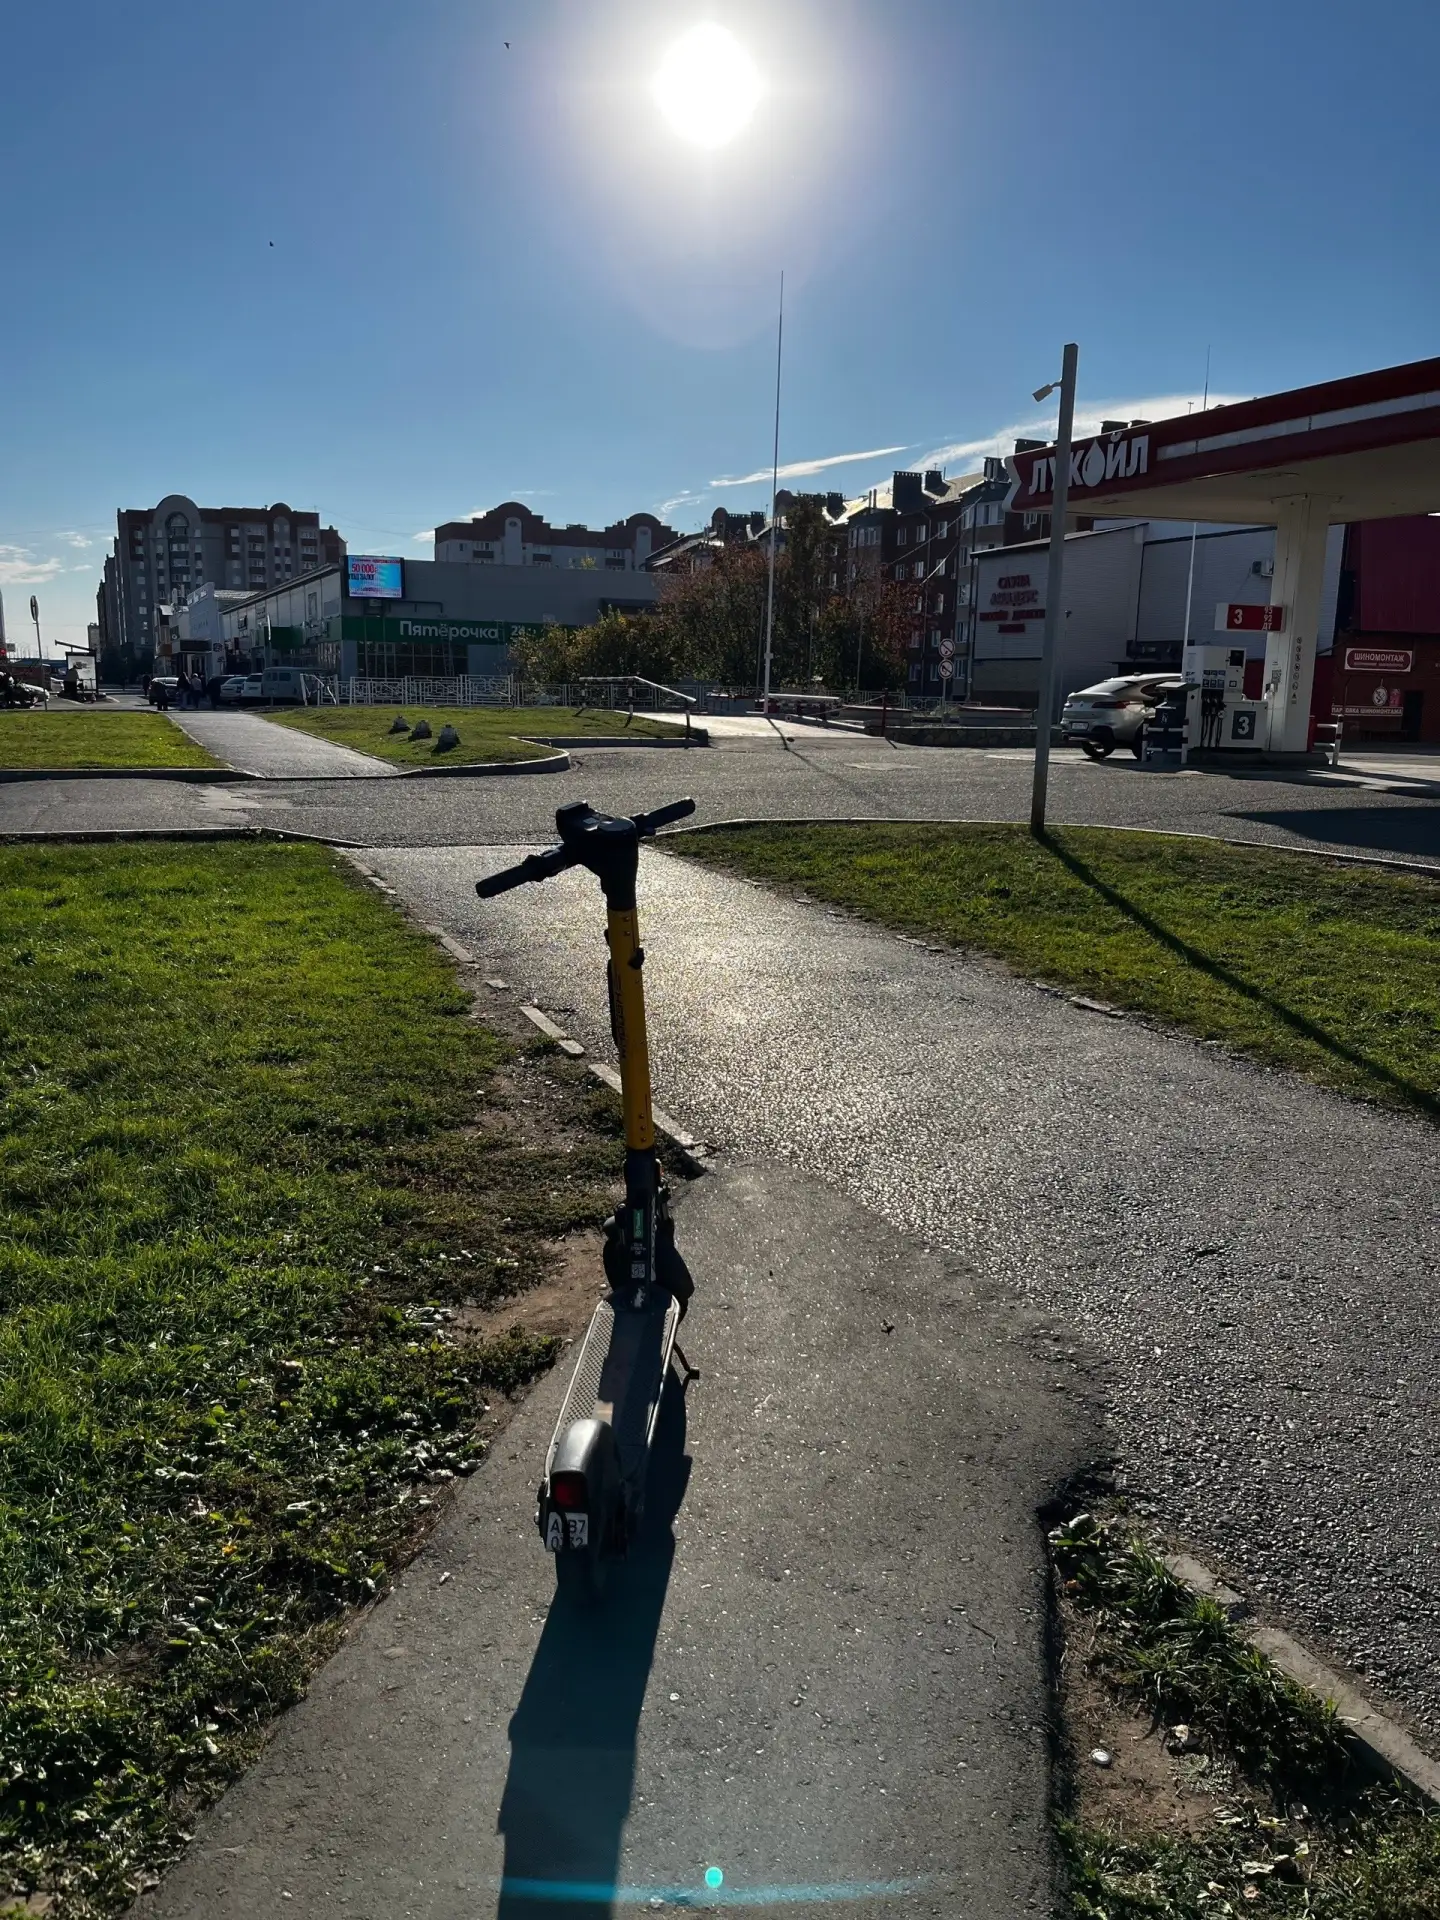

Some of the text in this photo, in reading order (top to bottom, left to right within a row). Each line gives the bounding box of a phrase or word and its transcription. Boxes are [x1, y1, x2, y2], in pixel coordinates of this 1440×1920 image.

[1264, 606, 1273, 614] 95
[1233, 608, 1243, 625] 3
[1263, 614, 1273, 622] 92
[400, 620, 499, 641] Пятёрочка
[1262, 622, 1273, 631] ДТ
[1354, 652, 1404, 662] ШИНОМОНТАЖ
[1237, 716, 1250, 735] 3
